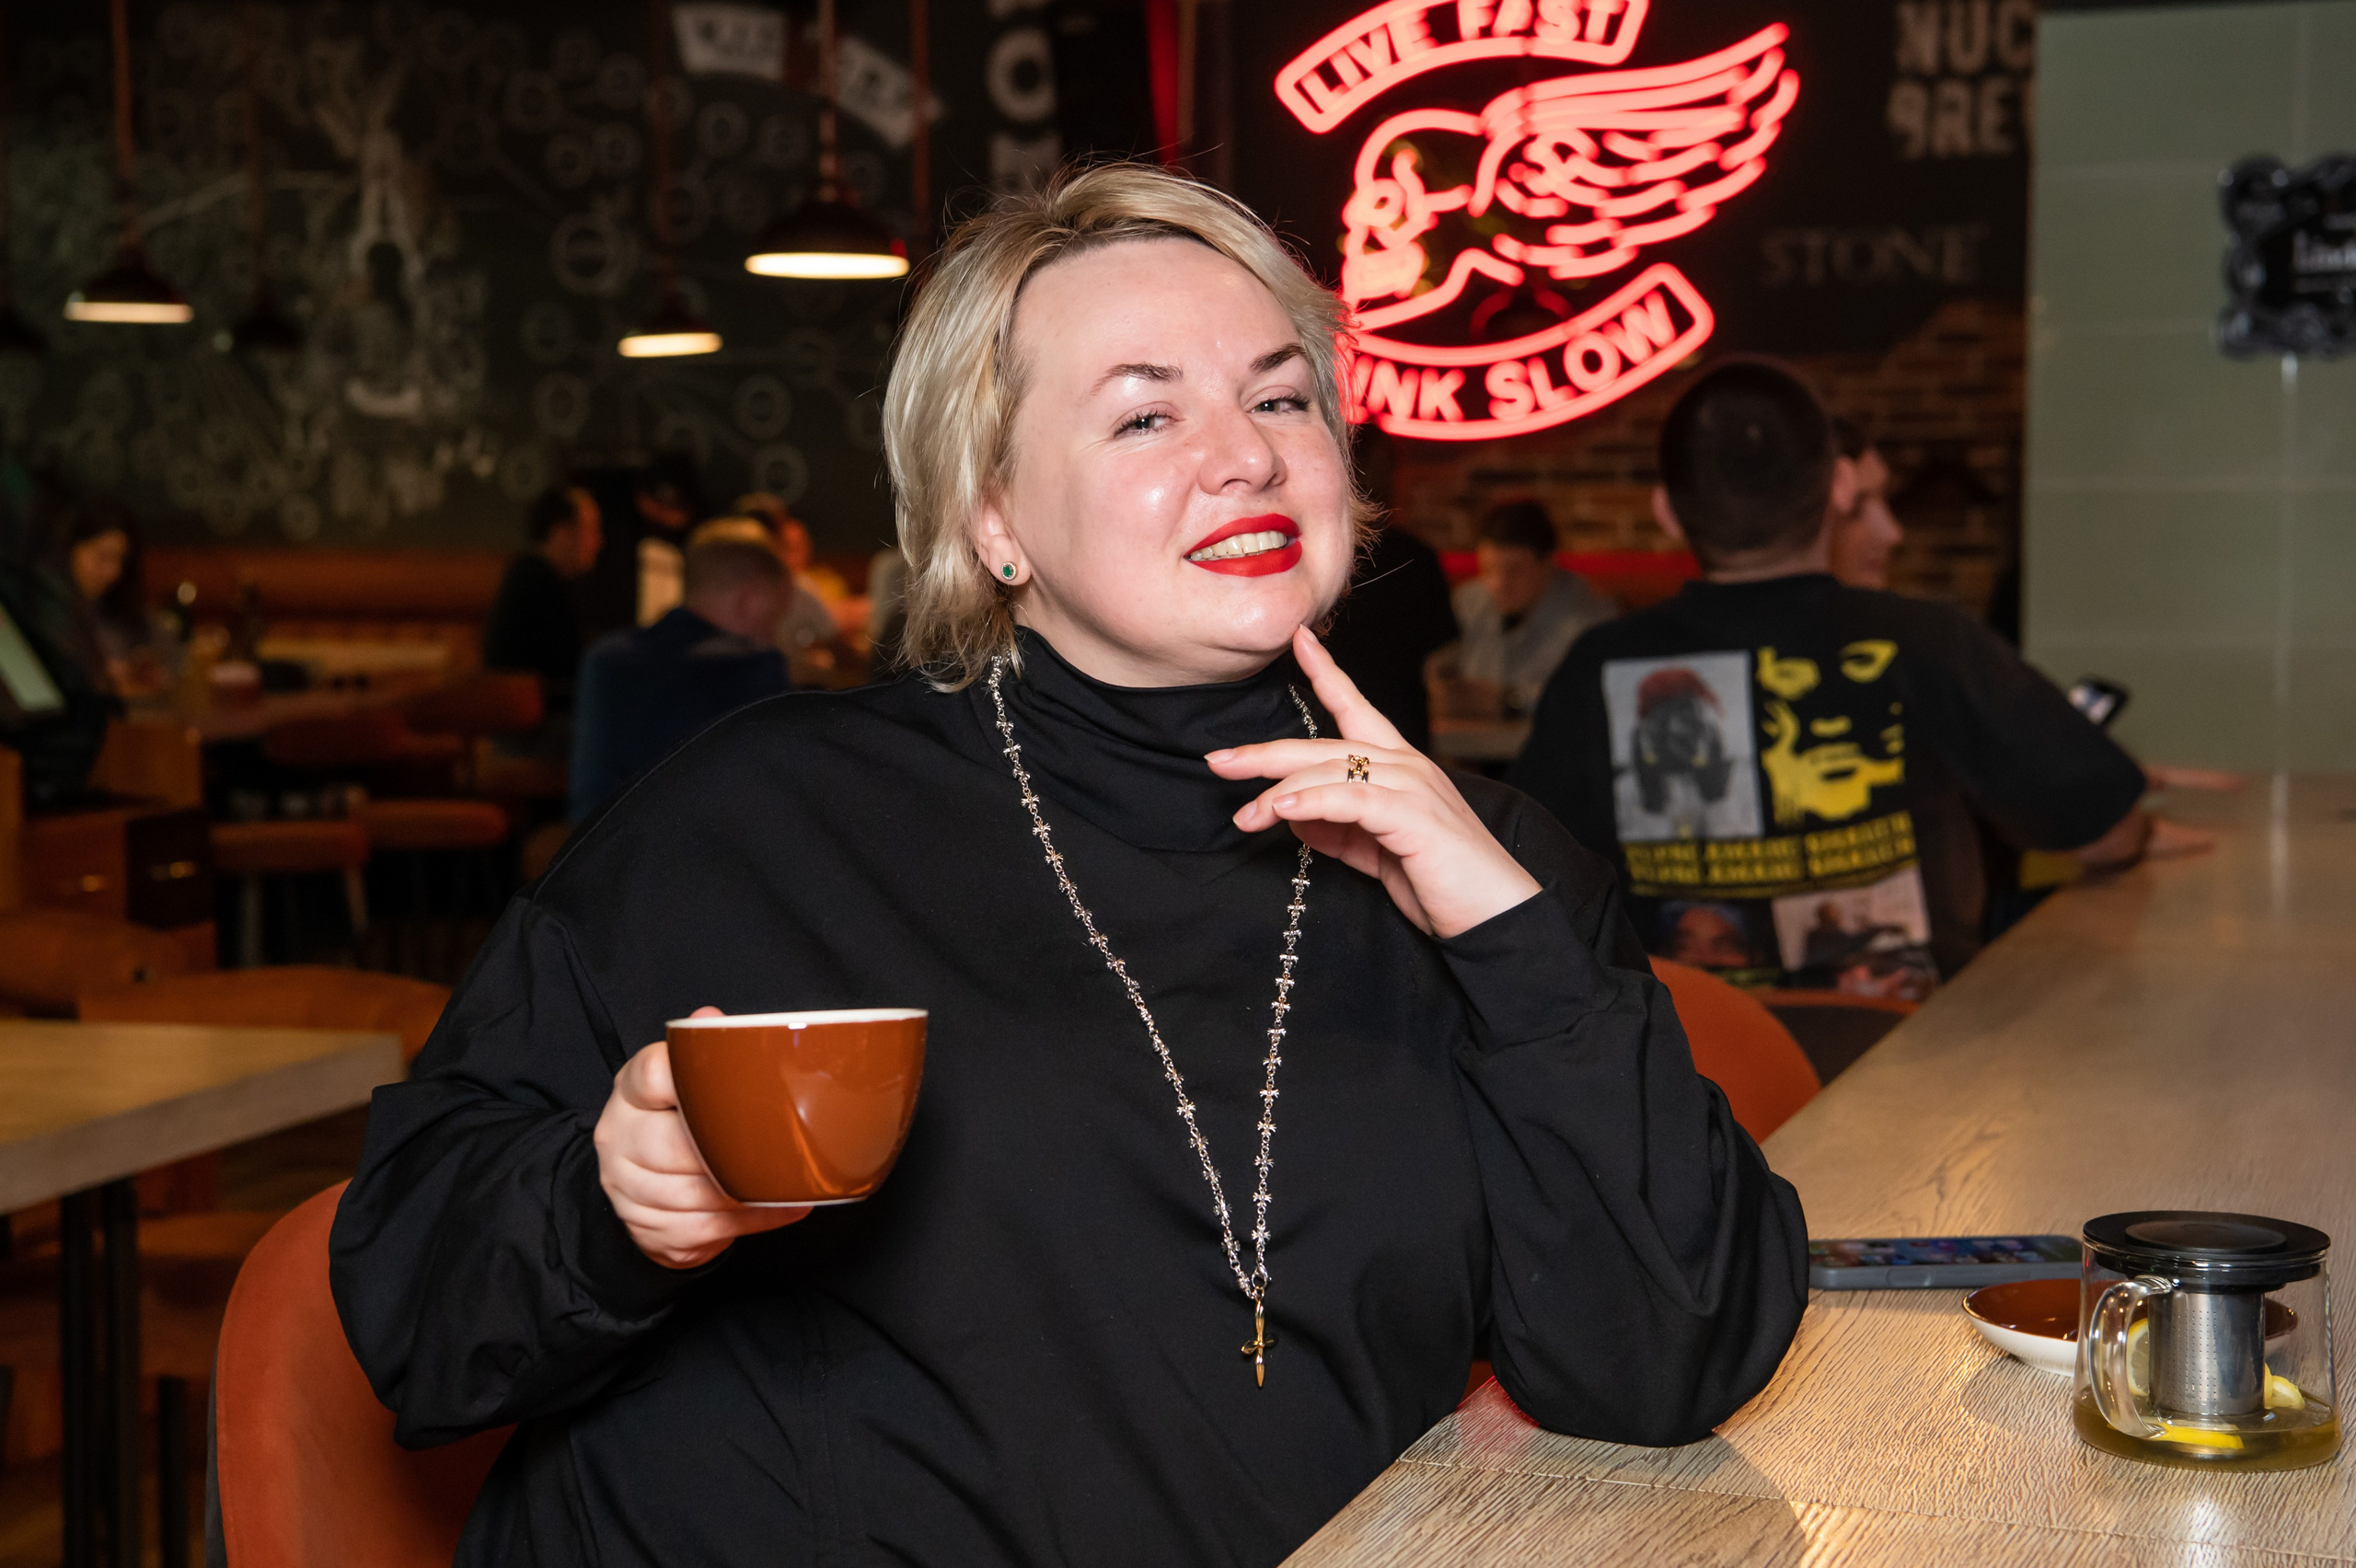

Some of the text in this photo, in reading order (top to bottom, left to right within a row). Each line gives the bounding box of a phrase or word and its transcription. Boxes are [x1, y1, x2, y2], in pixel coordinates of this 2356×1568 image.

[1299, 0, 1628, 110] LIVE FAST
[1759, 222, 1991, 287] STONE
[1485, 291, 1676, 421] SLOW
